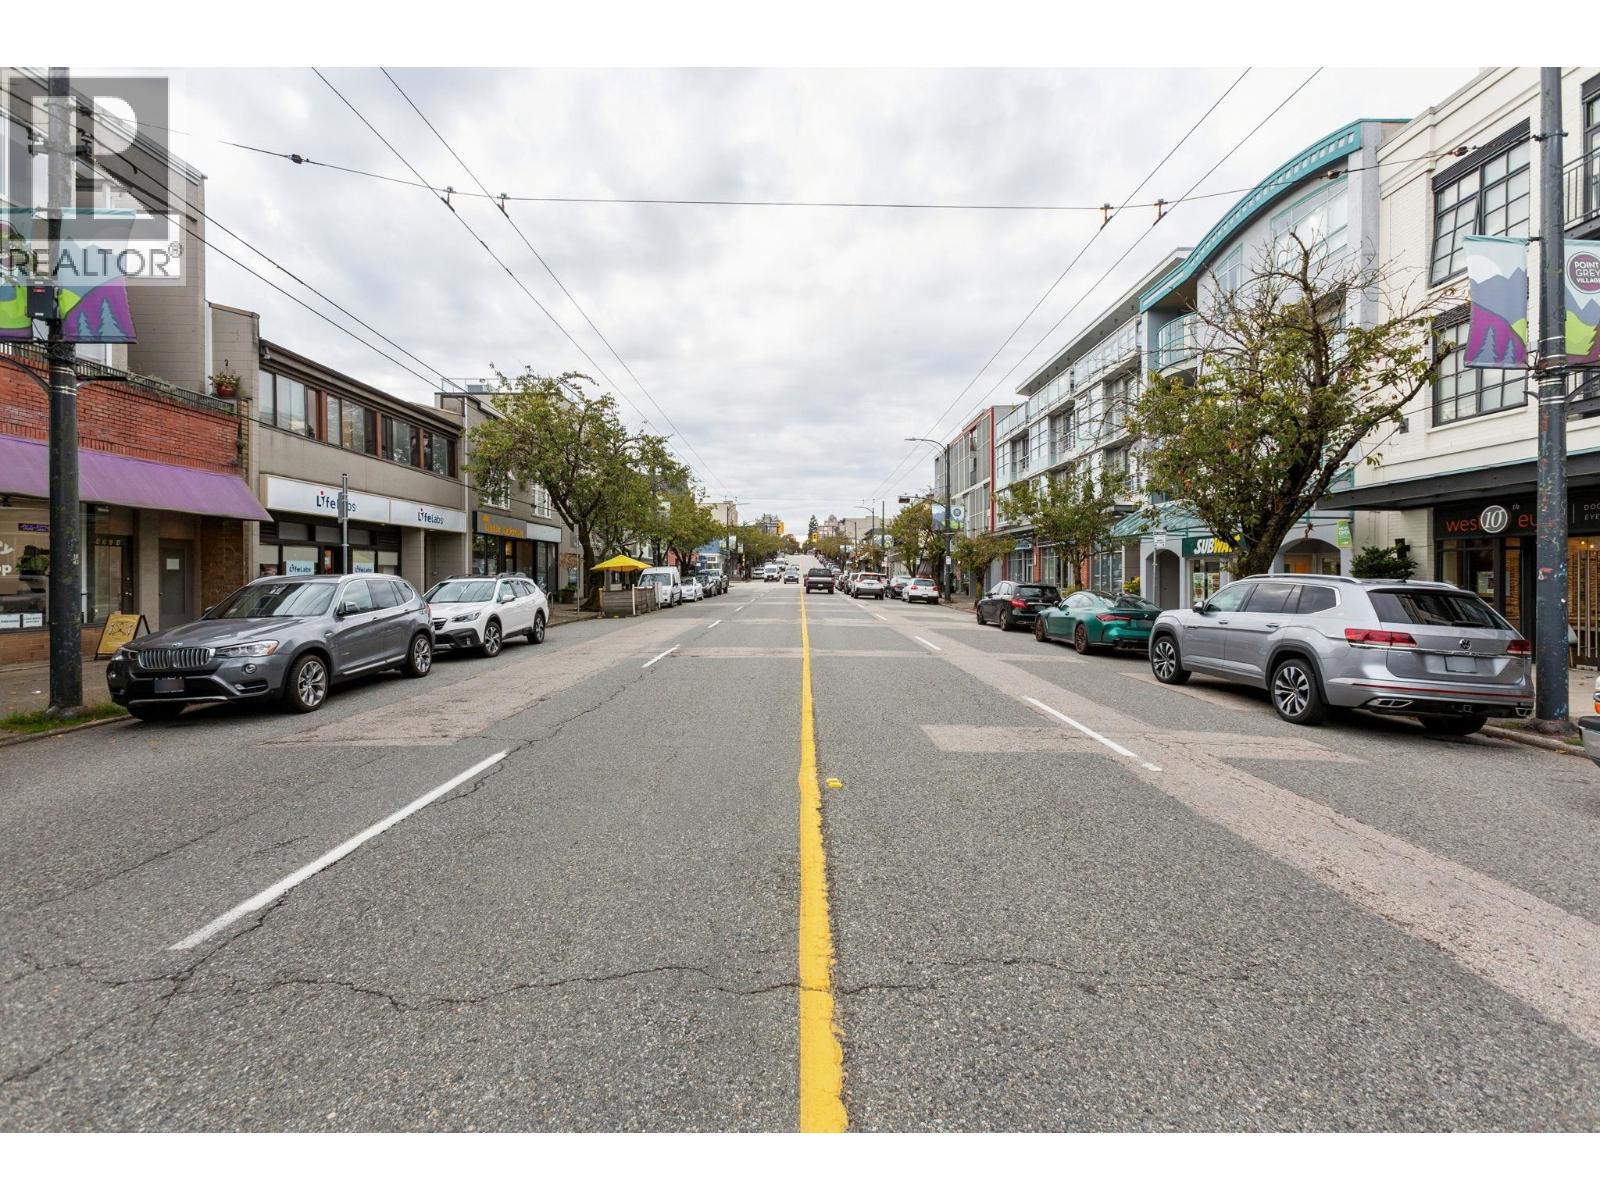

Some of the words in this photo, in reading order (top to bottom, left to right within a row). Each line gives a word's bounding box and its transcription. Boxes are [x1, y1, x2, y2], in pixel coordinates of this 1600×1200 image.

[1574, 261, 1599, 269] POINT
[1575, 269, 1600, 277] GREY
[316, 490, 357, 512] Lifebs
[417, 507, 444, 525] LifeLabs
[1193, 534, 1241, 555] SUBWA
